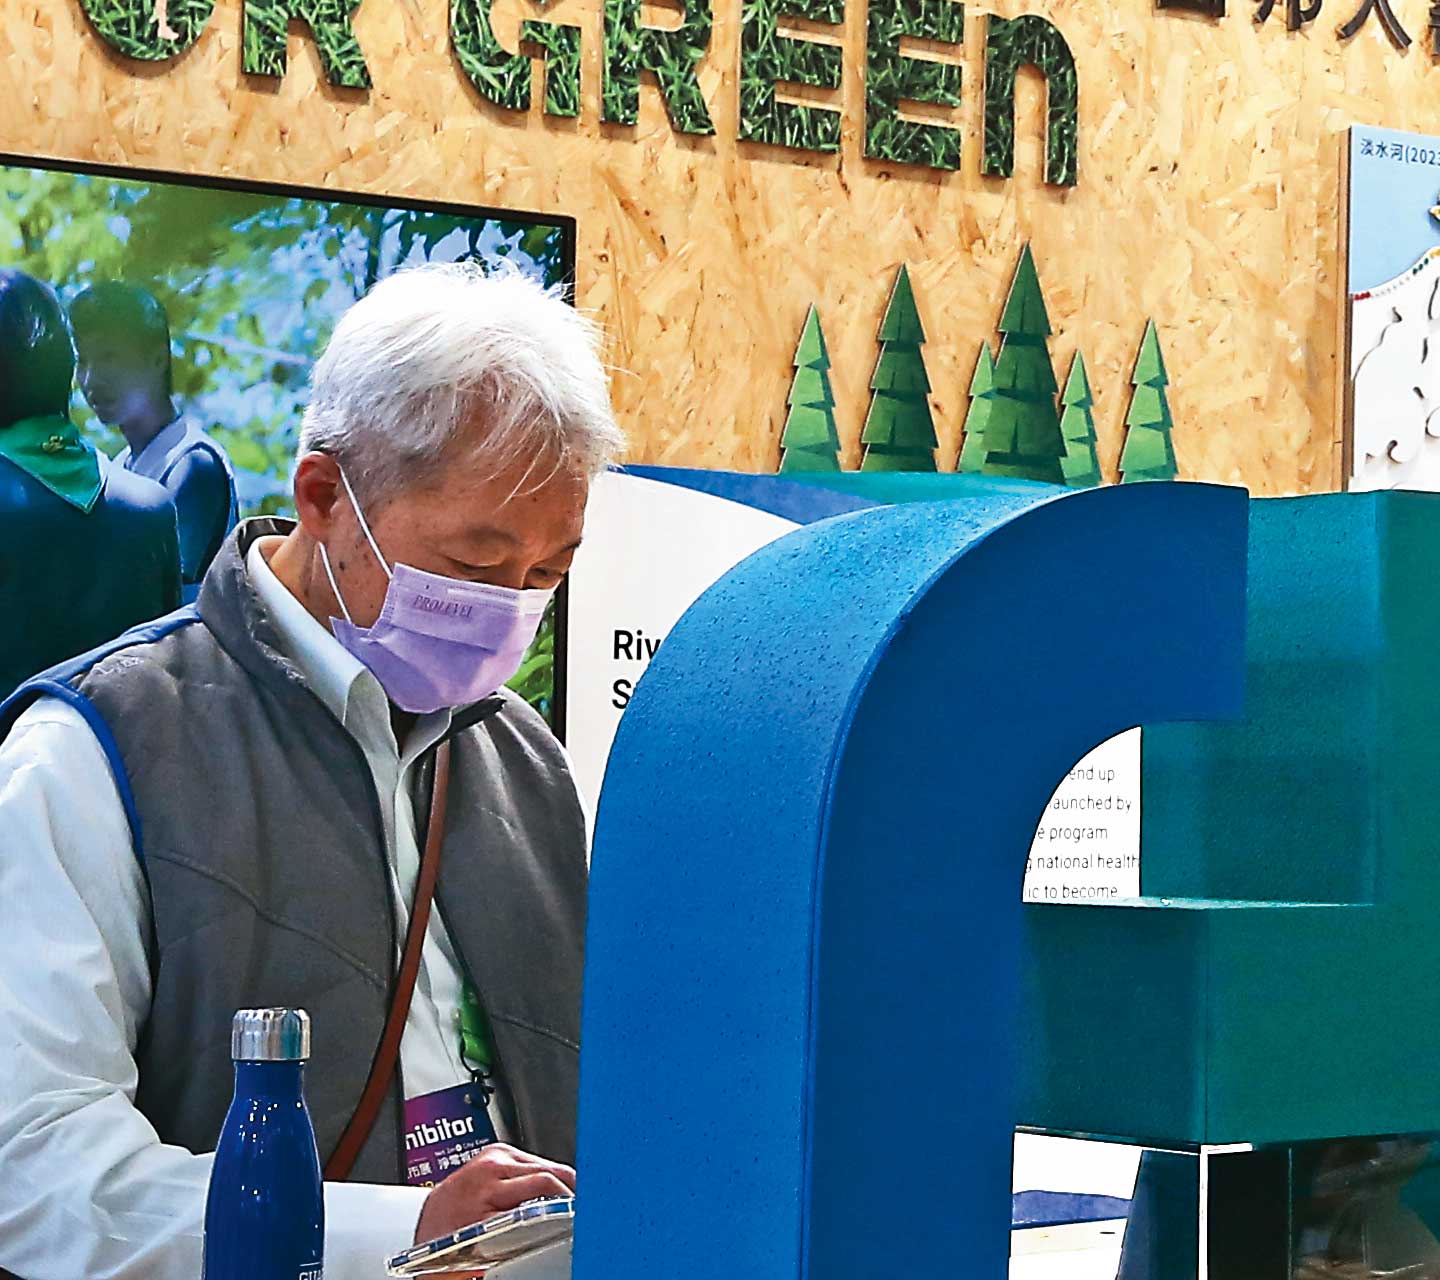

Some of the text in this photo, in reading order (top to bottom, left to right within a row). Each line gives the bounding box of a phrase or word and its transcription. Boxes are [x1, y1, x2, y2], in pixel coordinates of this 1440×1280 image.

[1099, 769, 1115, 784] up
[1117, 795, 1132, 813] by
[1050, 827, 1108, 843] program
[1037, 854, 1093, 869] national
[1045, 885, 1058, 899] to
[1062, 884, 1119, 900] become
